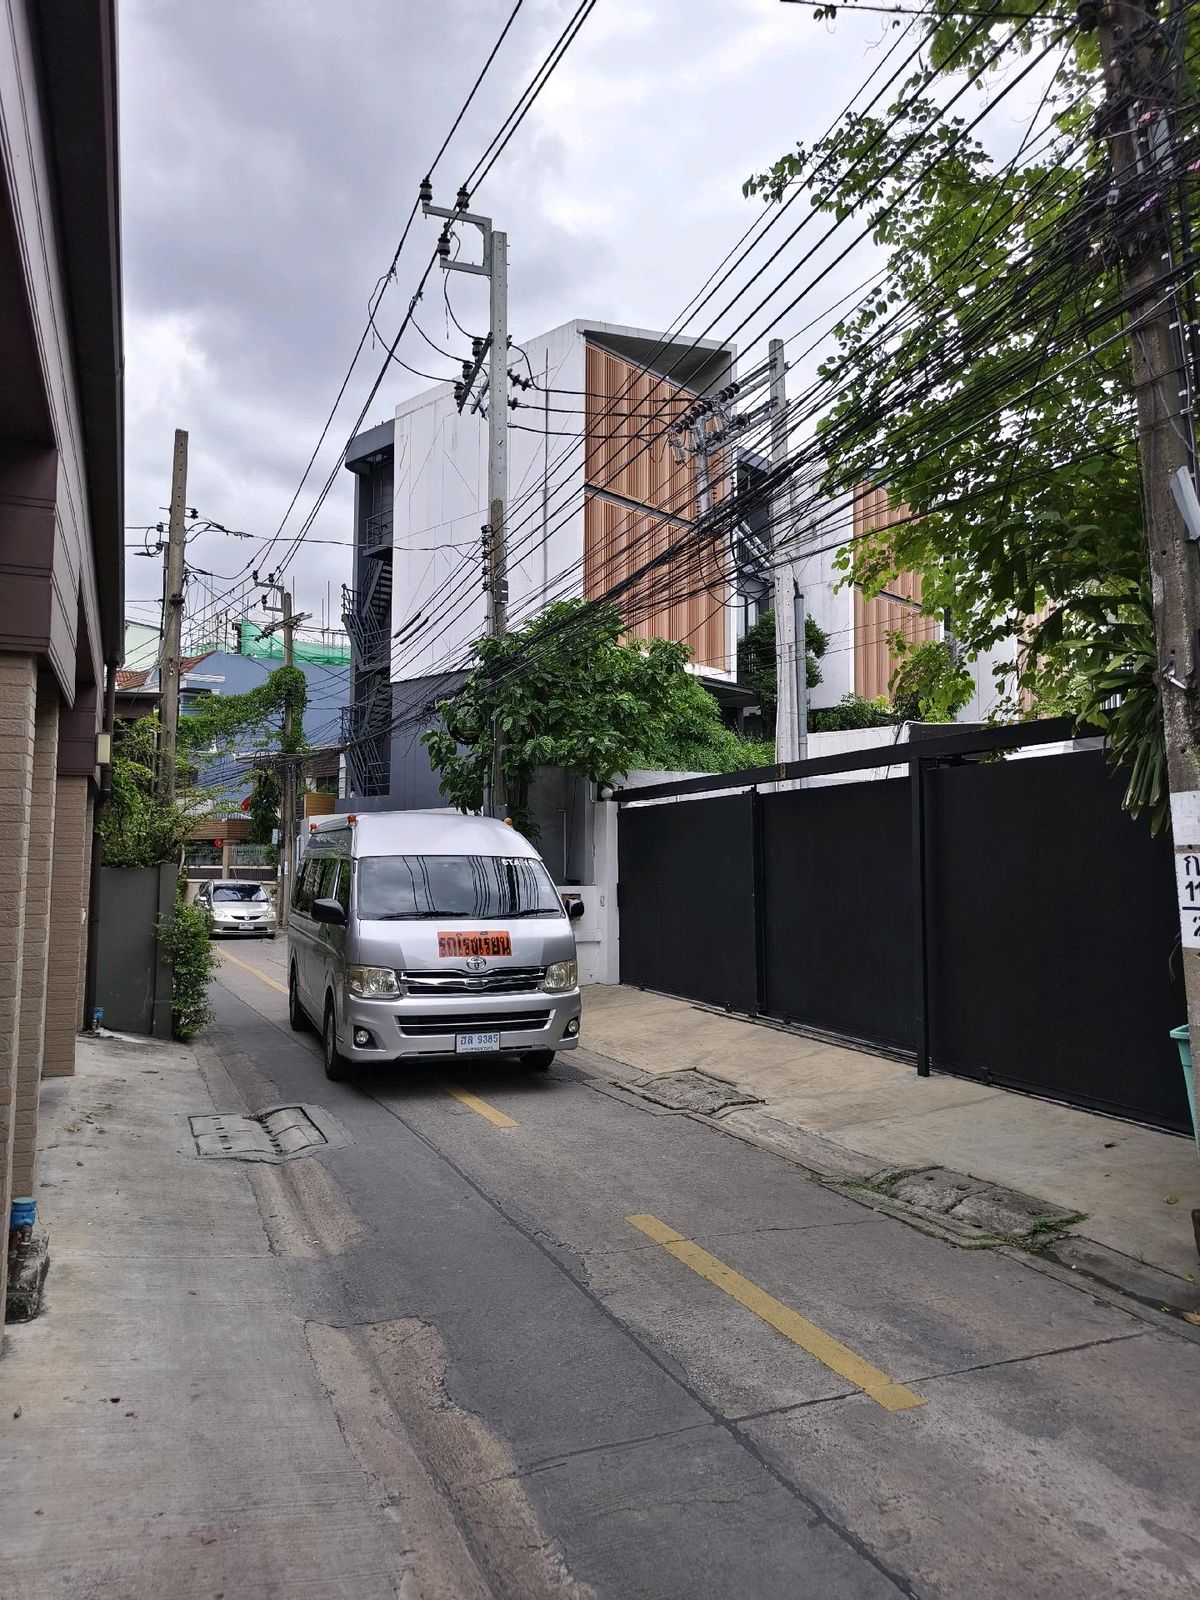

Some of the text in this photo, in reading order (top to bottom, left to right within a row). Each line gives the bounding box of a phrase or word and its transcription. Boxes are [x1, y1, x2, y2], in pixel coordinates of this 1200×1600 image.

[438, 931, 511, 956] รถโรงเรียน
[477, 1033, 499, 1044] 9385
